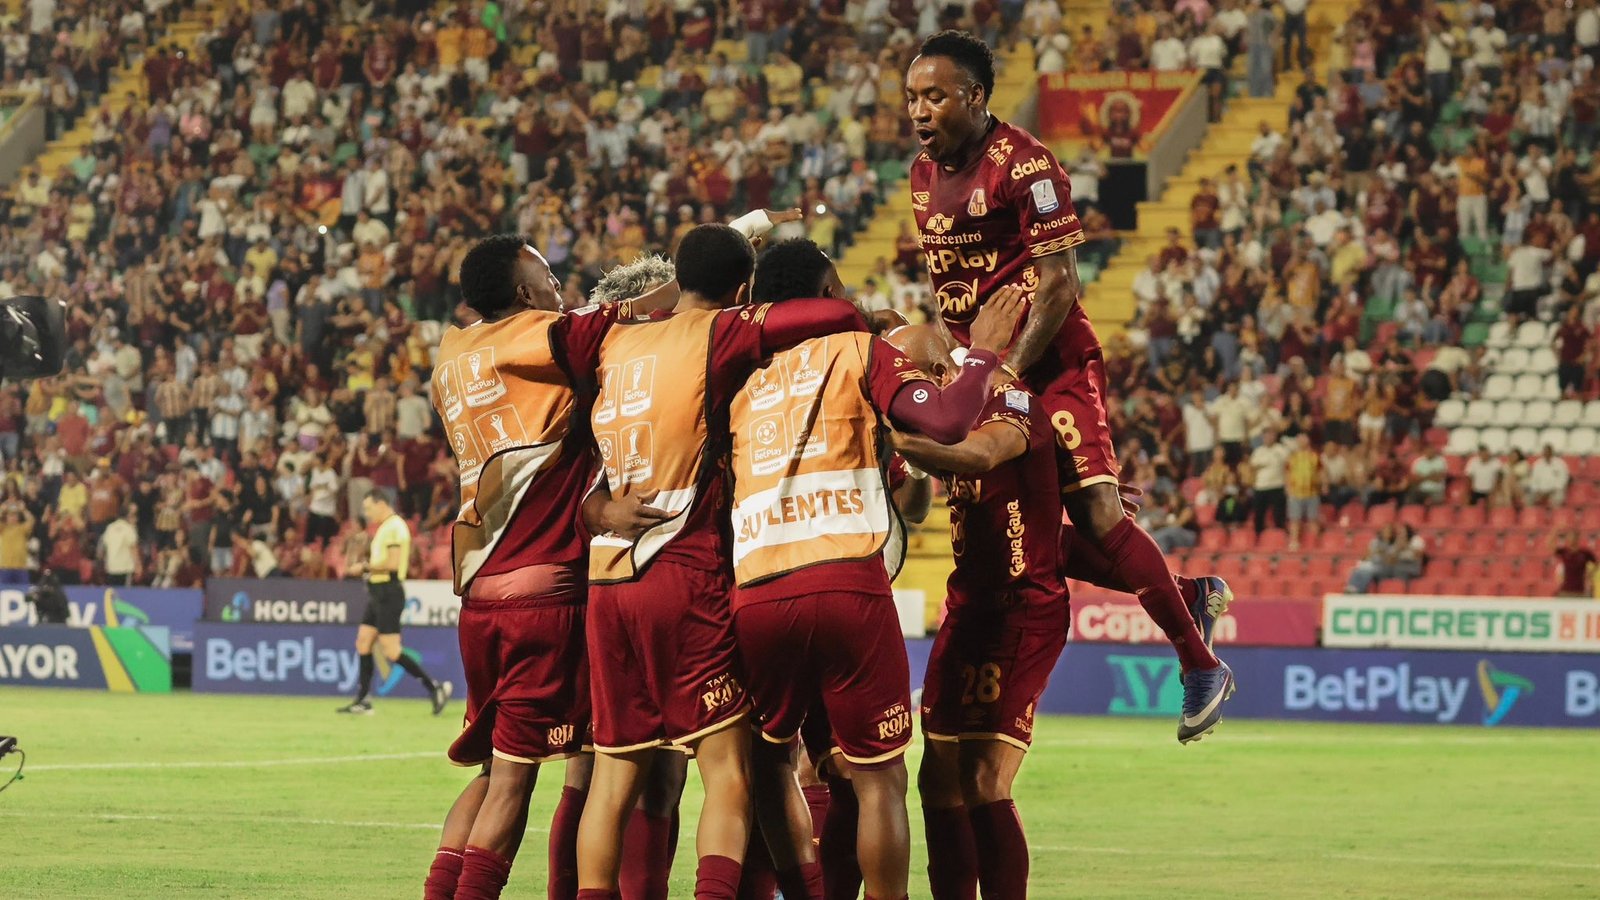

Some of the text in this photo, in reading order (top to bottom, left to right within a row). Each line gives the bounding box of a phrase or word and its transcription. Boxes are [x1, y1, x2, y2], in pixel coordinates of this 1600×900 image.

[1010, 155, 1051, 181] dale!
[1043, 215, 1077, 231] HOLCIM
[926, 247, 999, 275] tPlay
[466, 378, 496, 393] BetPlay
[1050, 410, 1081, 450] 8
[754, 447, 783, 461] BetPlay
[737, 488, 865, 544] SULENTES
[254, 599, 347, 624] HOLCIM
[1332, 608, 1551, 639] CONCRETOS
[206, 635, 361, 691] BetPlay
[701, 679, 743, 712] ROJA
[961, 662, 1002, 704] 28
[1284, 661, 1470, 723] BetPlay
[877, 710, 910, 740] ROJA
[883, 704, 905, 718] TAPA
[546, 723, 574, 746] ROJA
